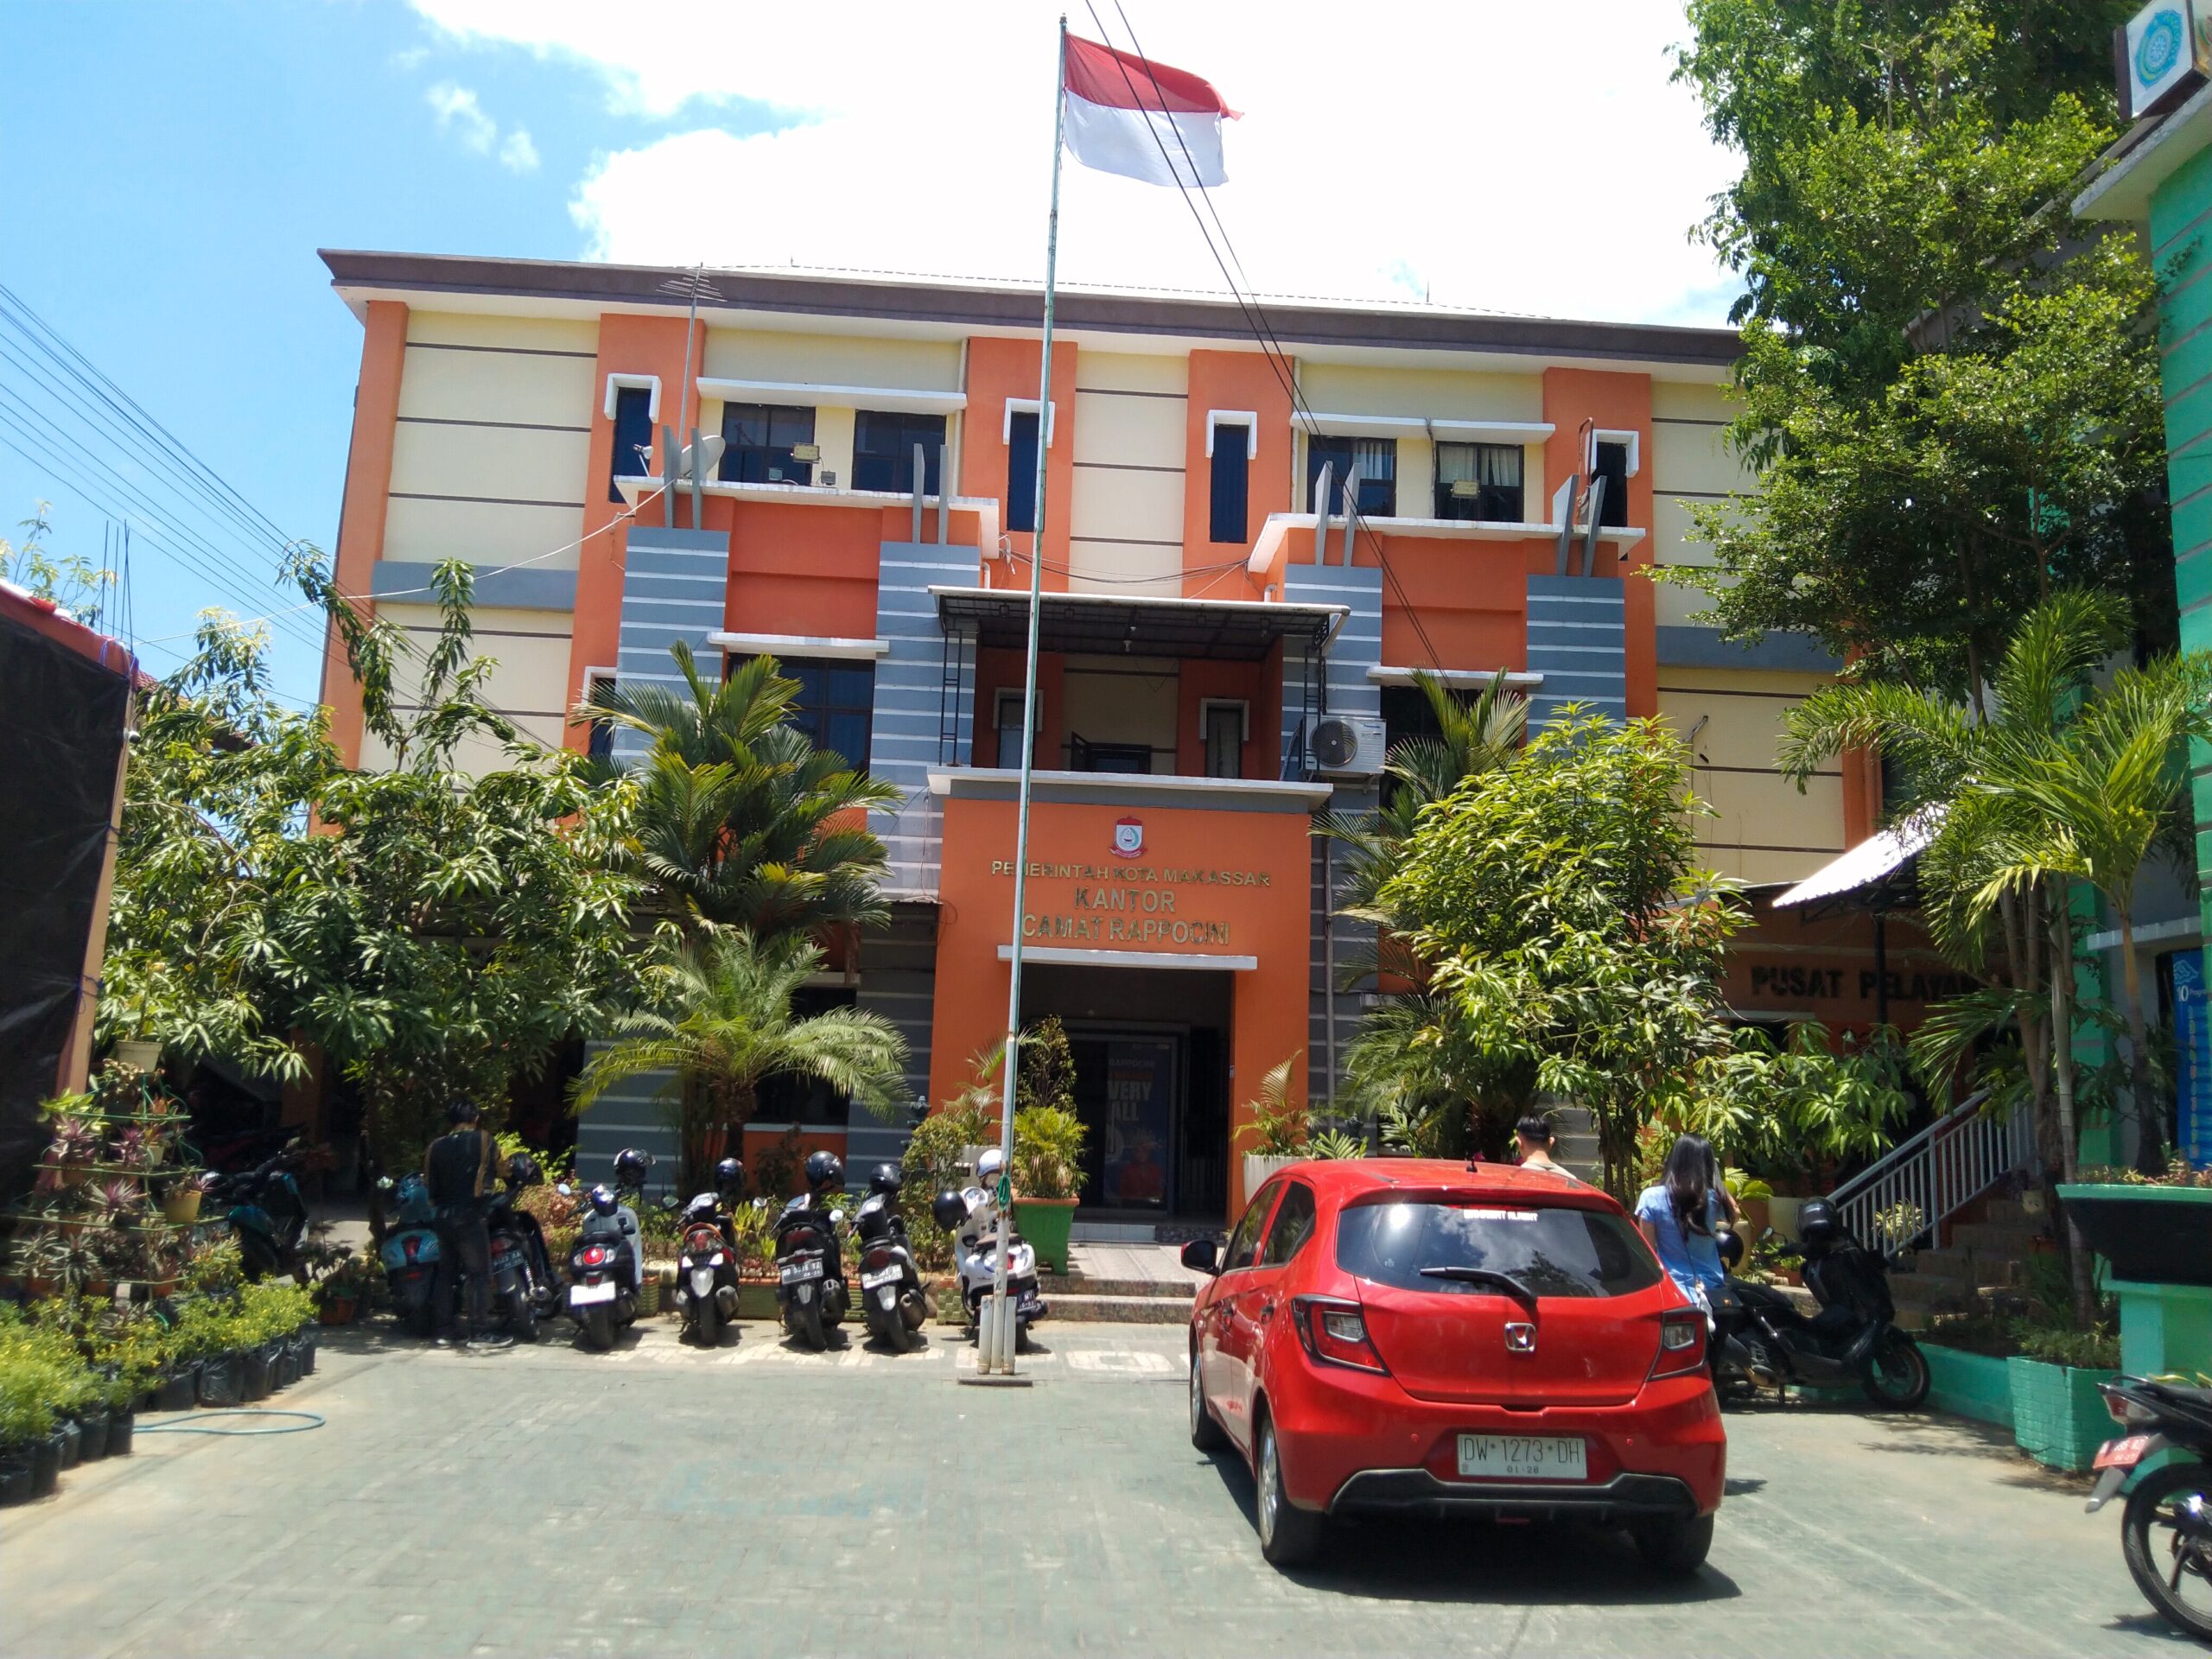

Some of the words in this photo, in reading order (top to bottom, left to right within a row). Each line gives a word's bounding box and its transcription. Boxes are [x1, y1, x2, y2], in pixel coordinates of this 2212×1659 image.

[991, 860, 1109, 881] PEERINTAH
[1114, 866, 1158, 883] KOTA
[1163, 868, 1271, 887] MAKASSAR
[1074, 887, 1176, 913] KANTOR
[1021, 913, 1104, 941] CAMAT
[1109, 918, 1230, 946] RAPPOCINI
[1750, 965, 1843, 999] PUSAT
[1464, 1438, 1487, 1461] DW
[1502, 1440, 1543, 1462] 1273
[1558, 1440, 1580, 1464] DH
